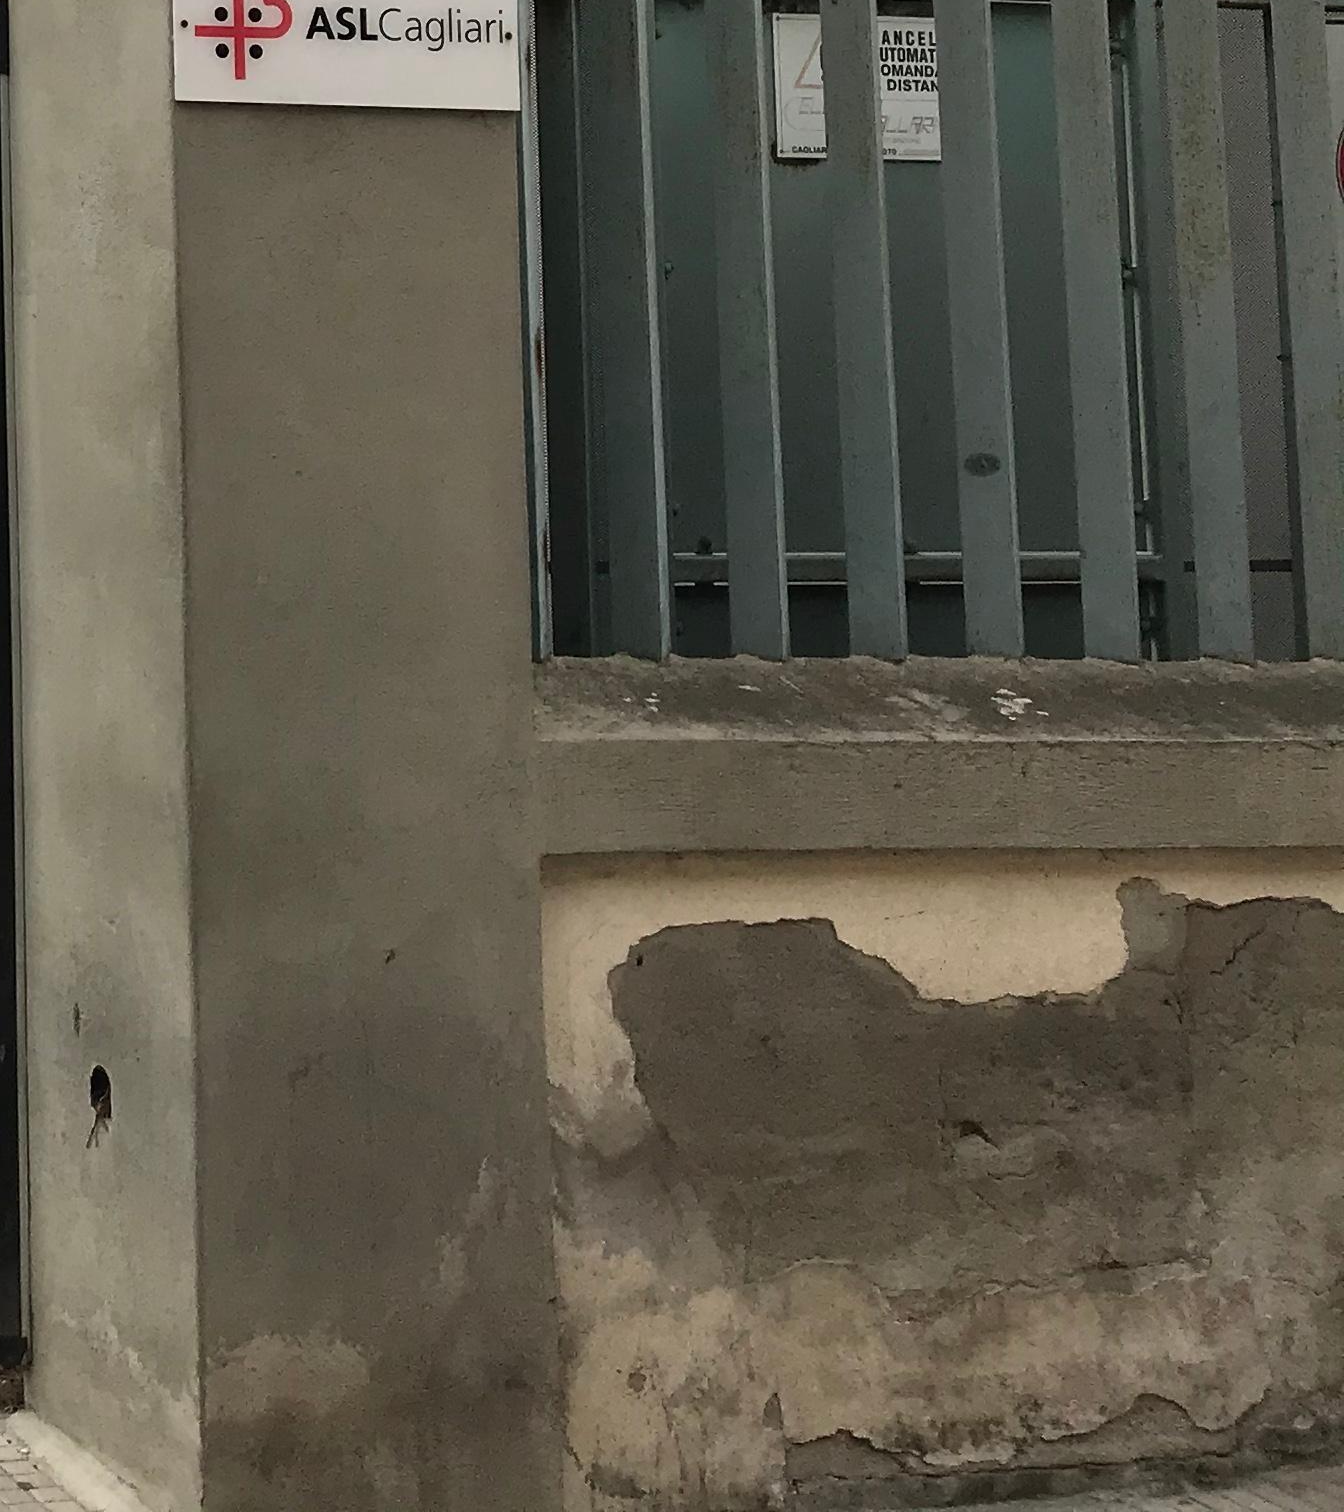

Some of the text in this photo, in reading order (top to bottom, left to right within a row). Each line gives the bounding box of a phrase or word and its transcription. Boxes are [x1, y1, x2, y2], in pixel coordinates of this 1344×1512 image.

[881, 29, 937, 46] ANCEL
[879, 46, 936, 63] UTOMAT
[880, 63, 937, 78] OMAND
[886, 78, 939, 92] DISTAN
